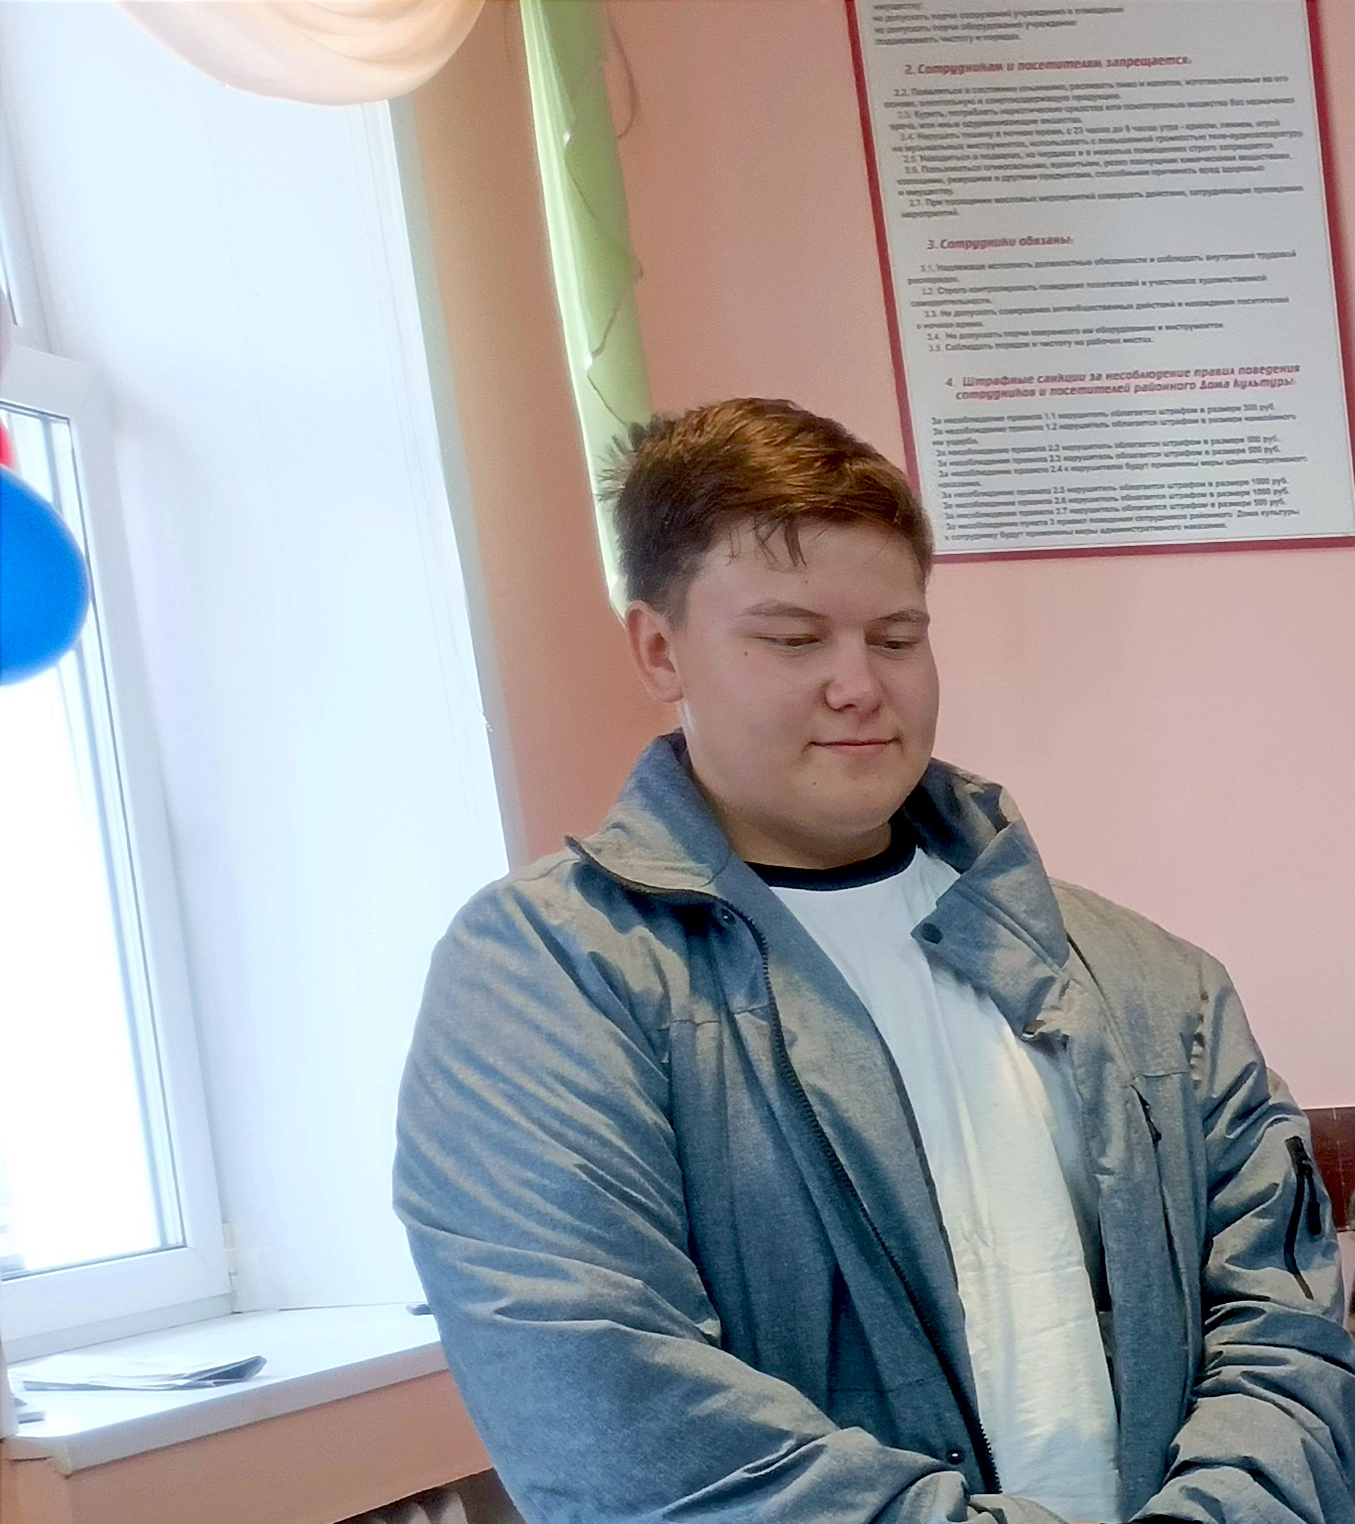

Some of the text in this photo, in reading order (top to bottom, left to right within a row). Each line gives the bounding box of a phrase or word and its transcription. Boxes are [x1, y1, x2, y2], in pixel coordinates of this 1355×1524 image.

[1007, 63, 1014, 71] и
[941, 238, 1016, 249] Сотрудники
[963, 376, 1034, 386] Штрафные
[1037, 374, 1086, 383] санкции
[1090, 373, 1102, 381] за
[1106, 369, 1191, 380] несоблюдение
[1194, 368, 1235, 378] правил
[1238, 365, 1300, 375] поведения
[956, 389, 1035, 400] сотрудников
[1051, 384, 1130, 395] посетителей
[1134, 382, 1196, 393] районного
[1199, 380, 1229, 389] Дома
